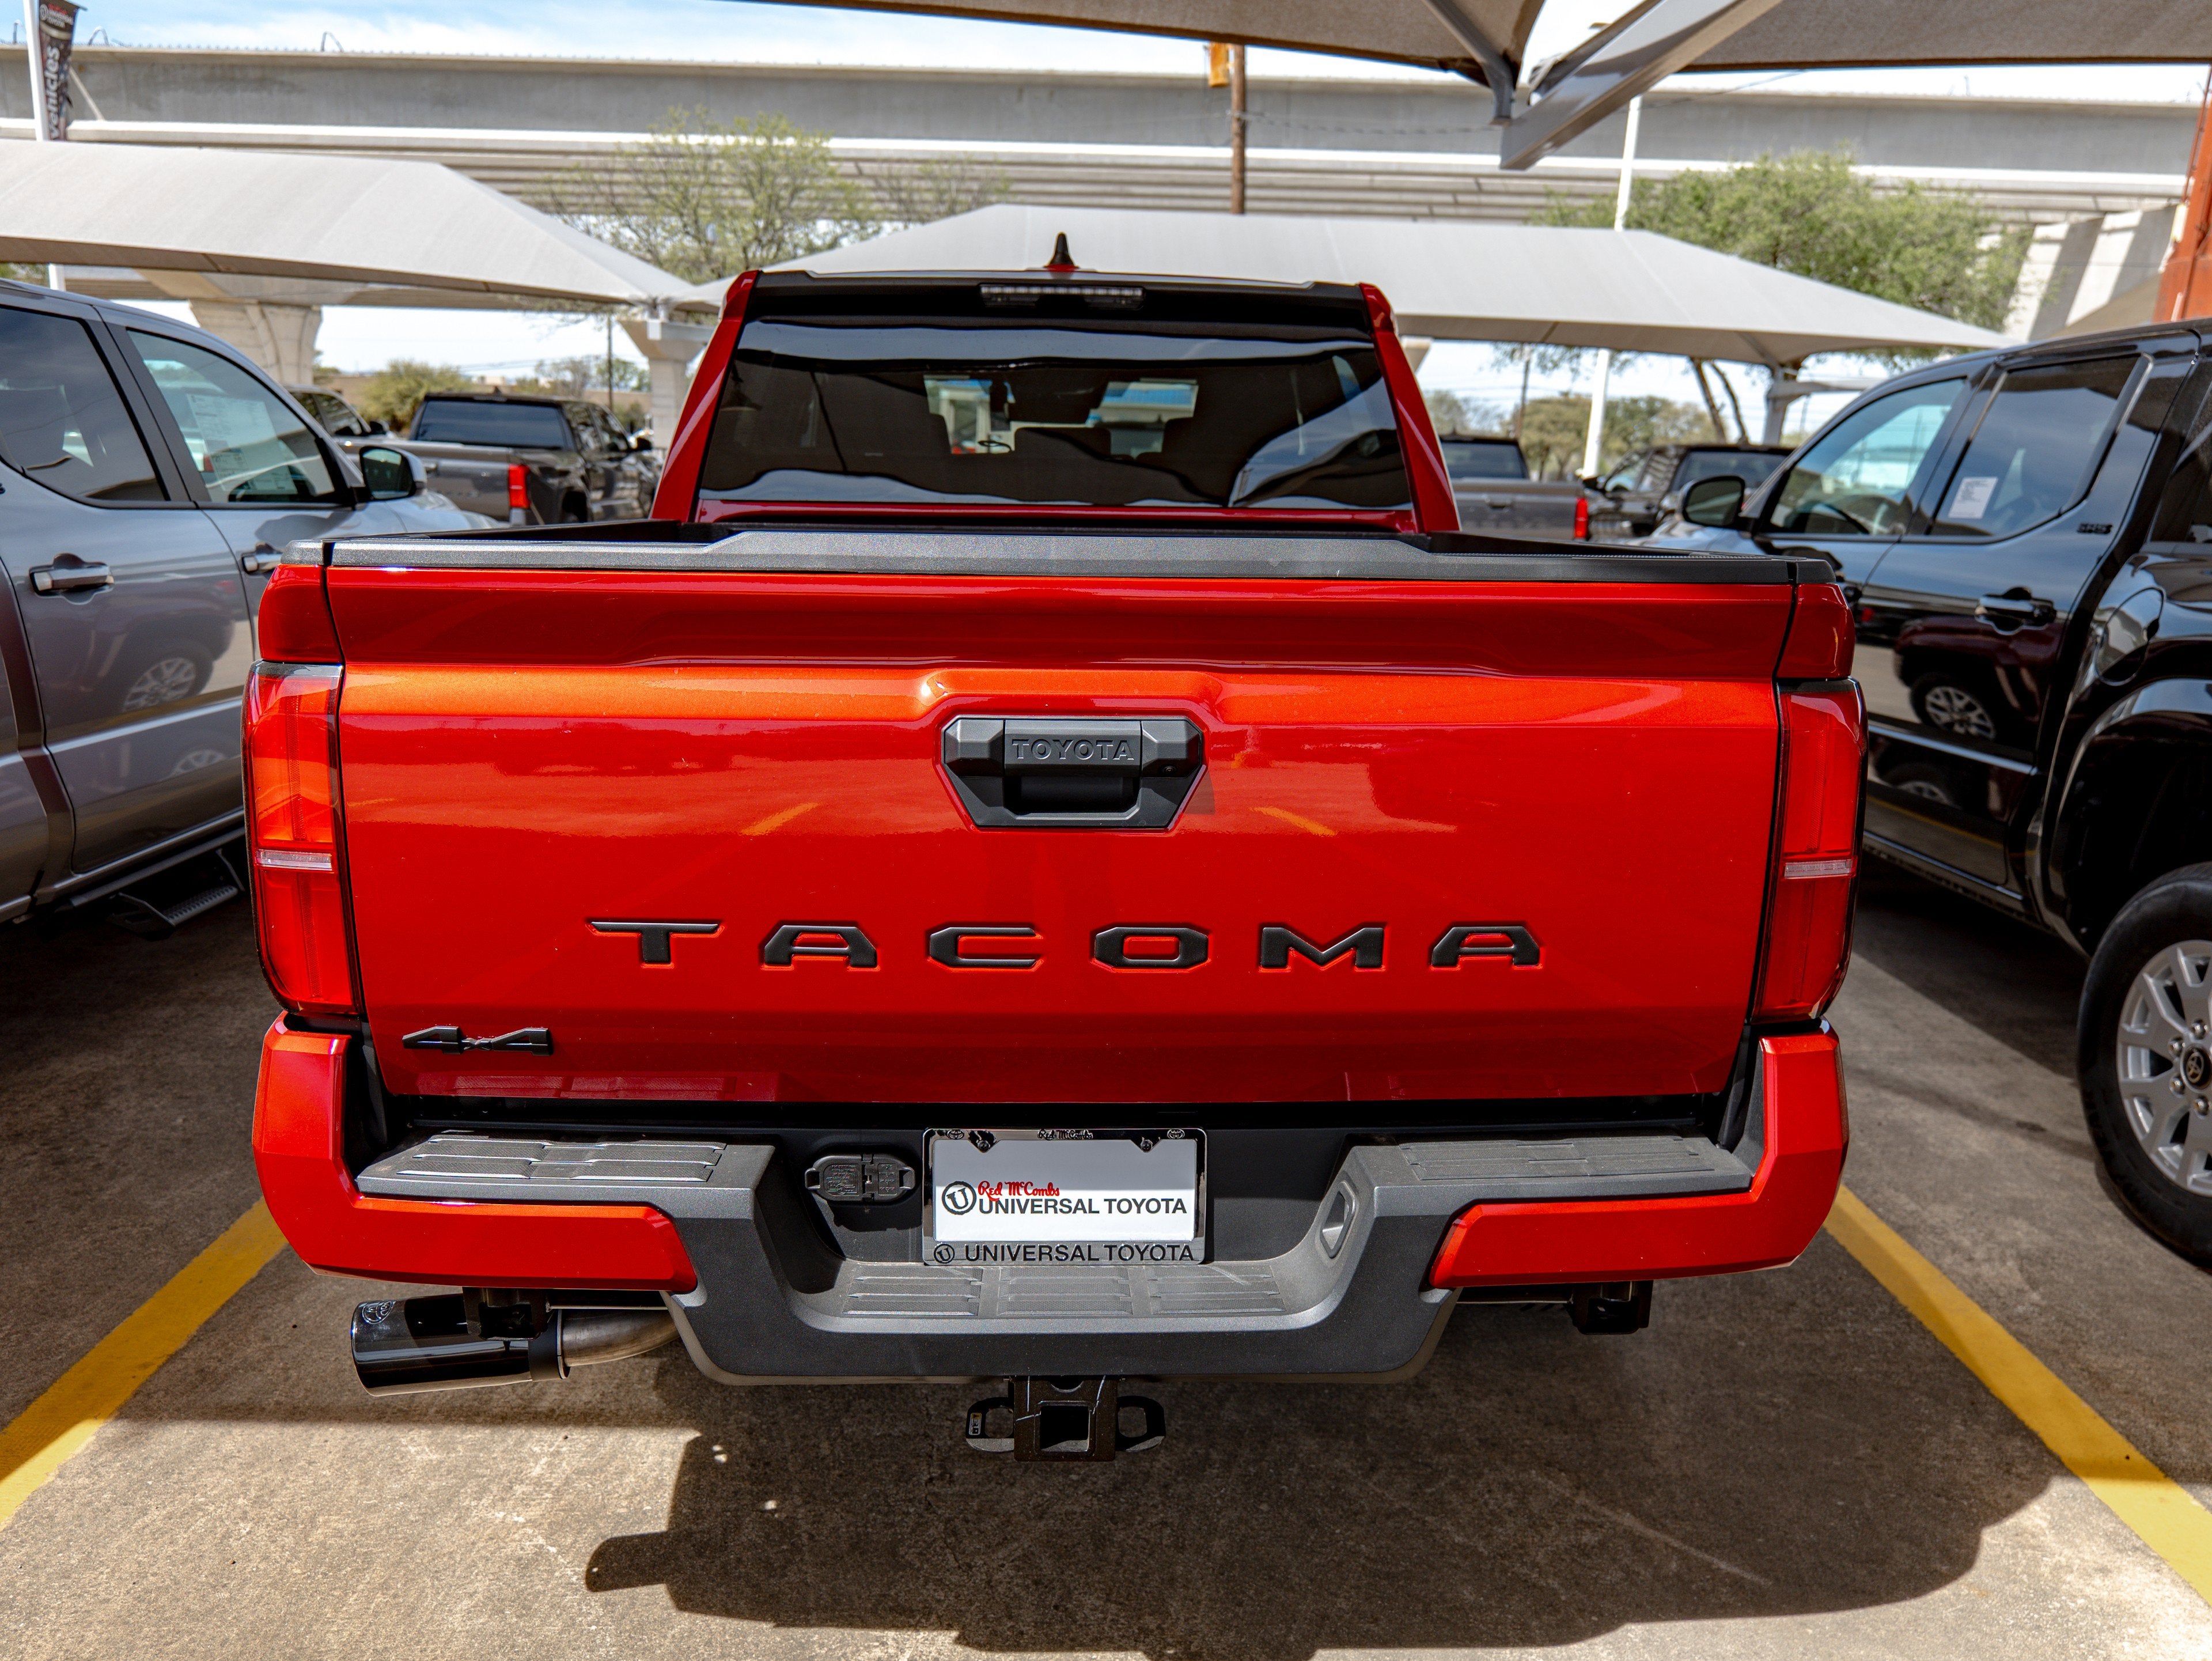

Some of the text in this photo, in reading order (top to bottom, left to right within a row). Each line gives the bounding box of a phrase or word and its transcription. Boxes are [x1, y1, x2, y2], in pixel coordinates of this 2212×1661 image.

[1012, 739, 1135, 760] TOYOTA
[589, 922, 1541, 971] TACOMA
[978, 1181, 1060, 1202] Red McCombs
[979, 1198, 1187, 1214] UNIVERSAL TOYOTA
[965, 1244, 1194, 1262] UNIVERSAL TOYOTA
